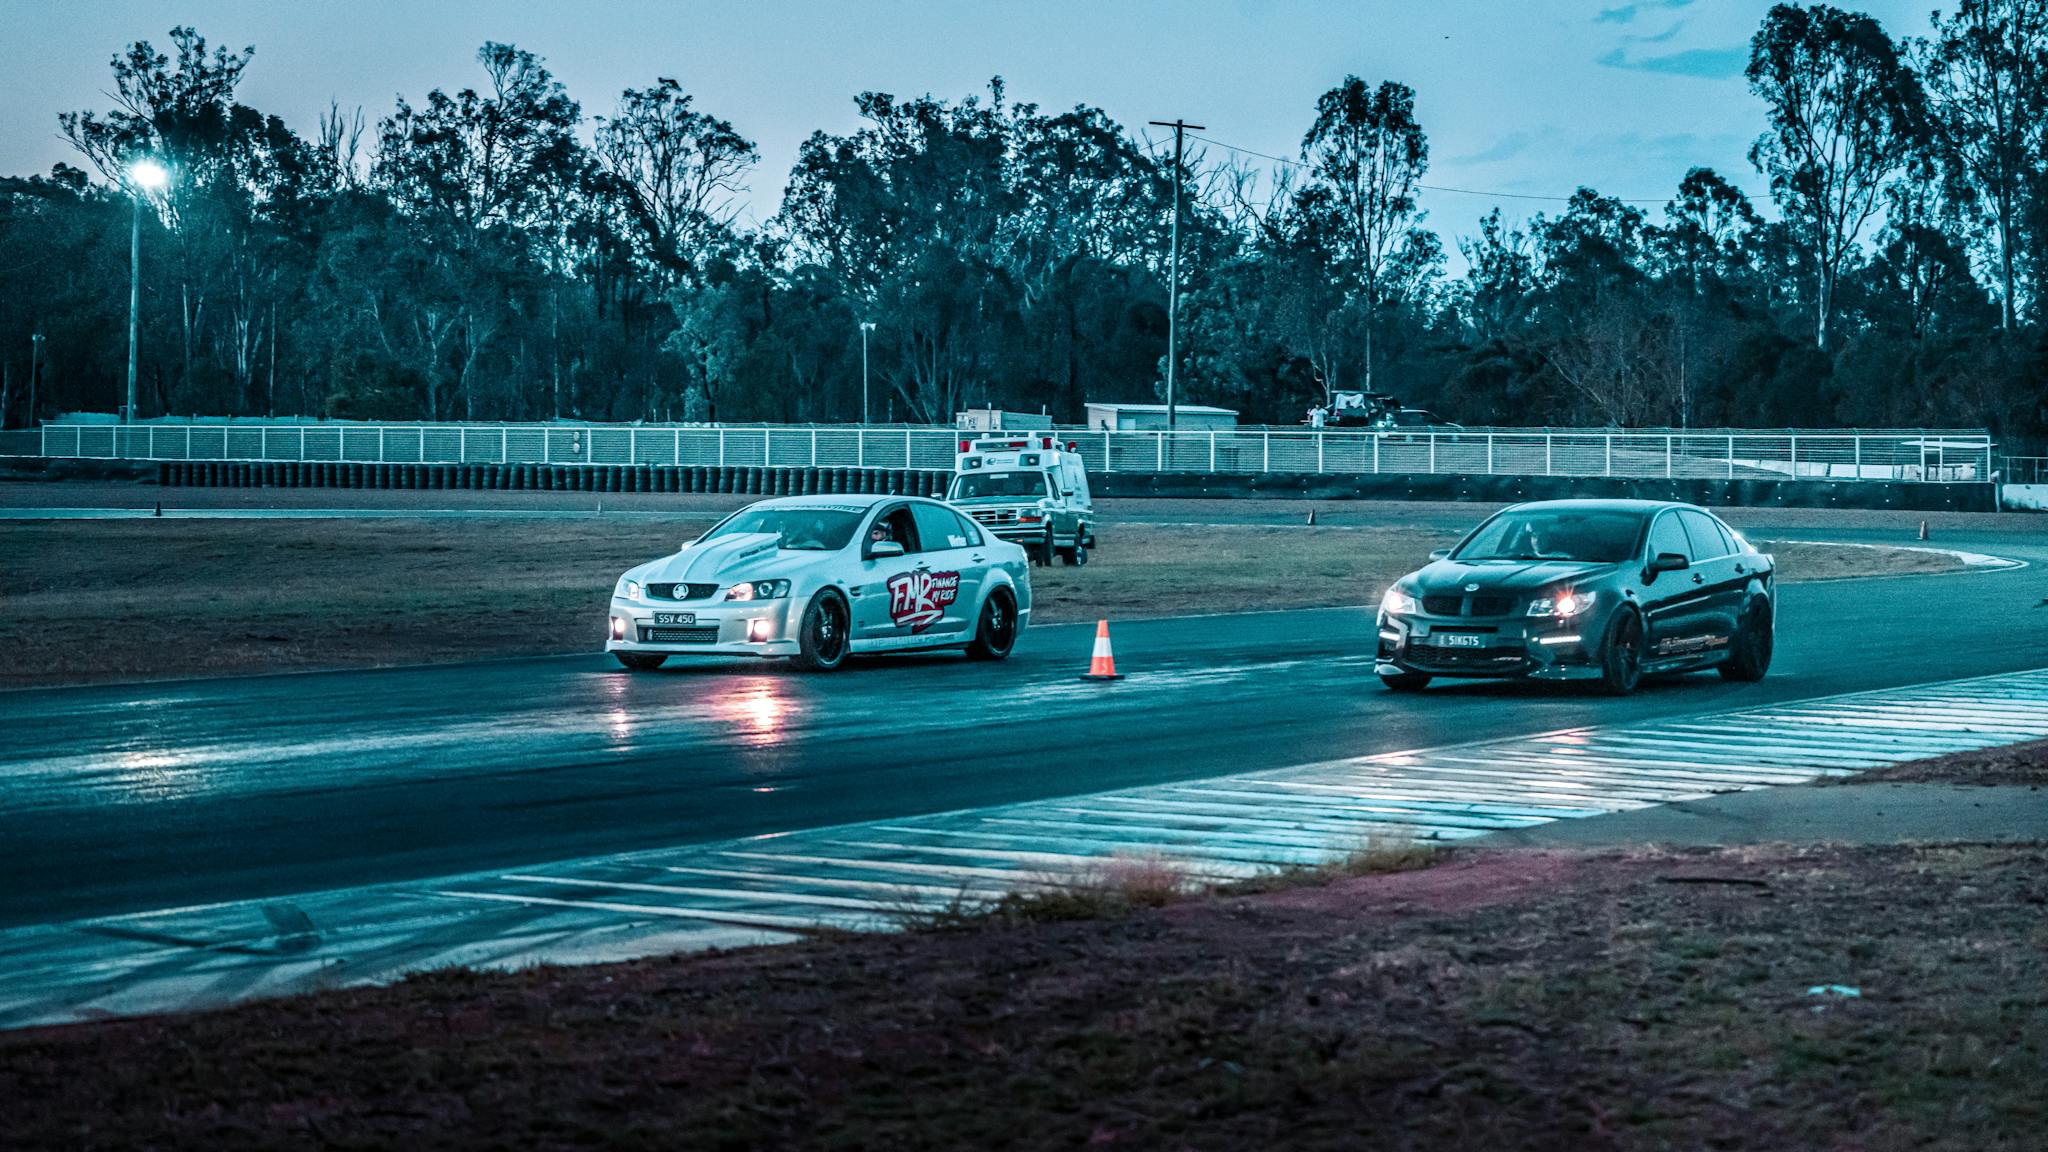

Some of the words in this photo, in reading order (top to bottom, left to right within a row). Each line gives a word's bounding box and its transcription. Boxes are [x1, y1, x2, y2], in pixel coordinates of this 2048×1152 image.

[931, 576, 958, 588] FINANCE
[940, 589, 956, 601] RIDE
[659, 614, 675, 623] SSV
[677, 614, 694, 623] 450
